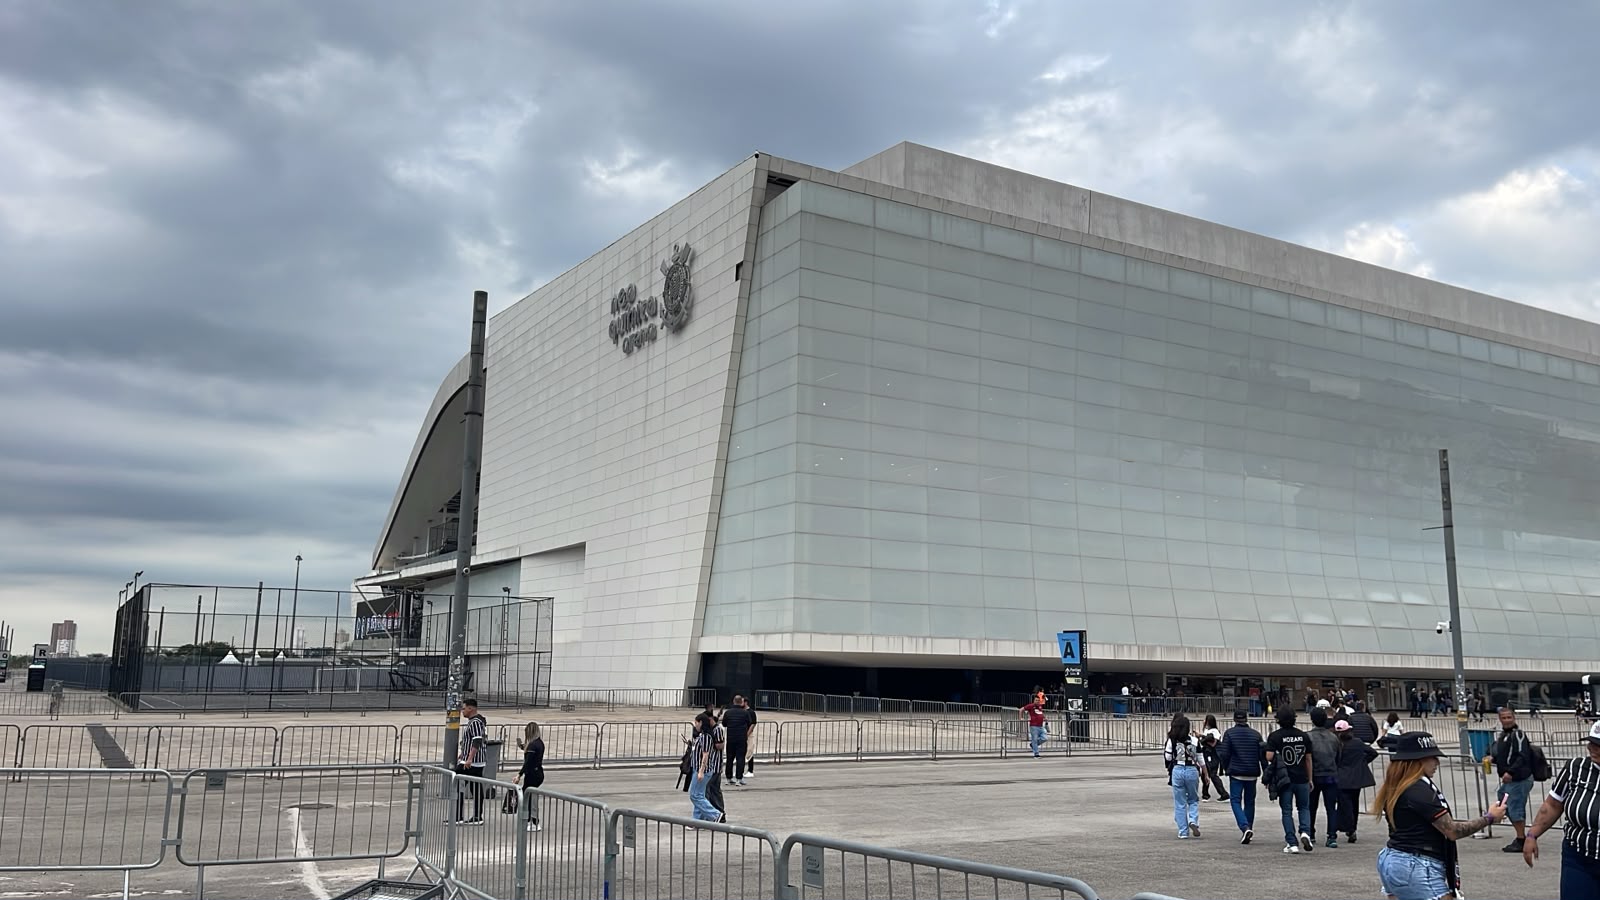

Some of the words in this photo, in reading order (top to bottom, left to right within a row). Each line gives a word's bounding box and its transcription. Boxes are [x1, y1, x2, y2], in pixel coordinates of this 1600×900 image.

[611, 283, 637, 317] neo
[622, 323, 657, 354] arena
[1063, 642, 1075, 658] A
[1282, 744, 1306, 766] 07
